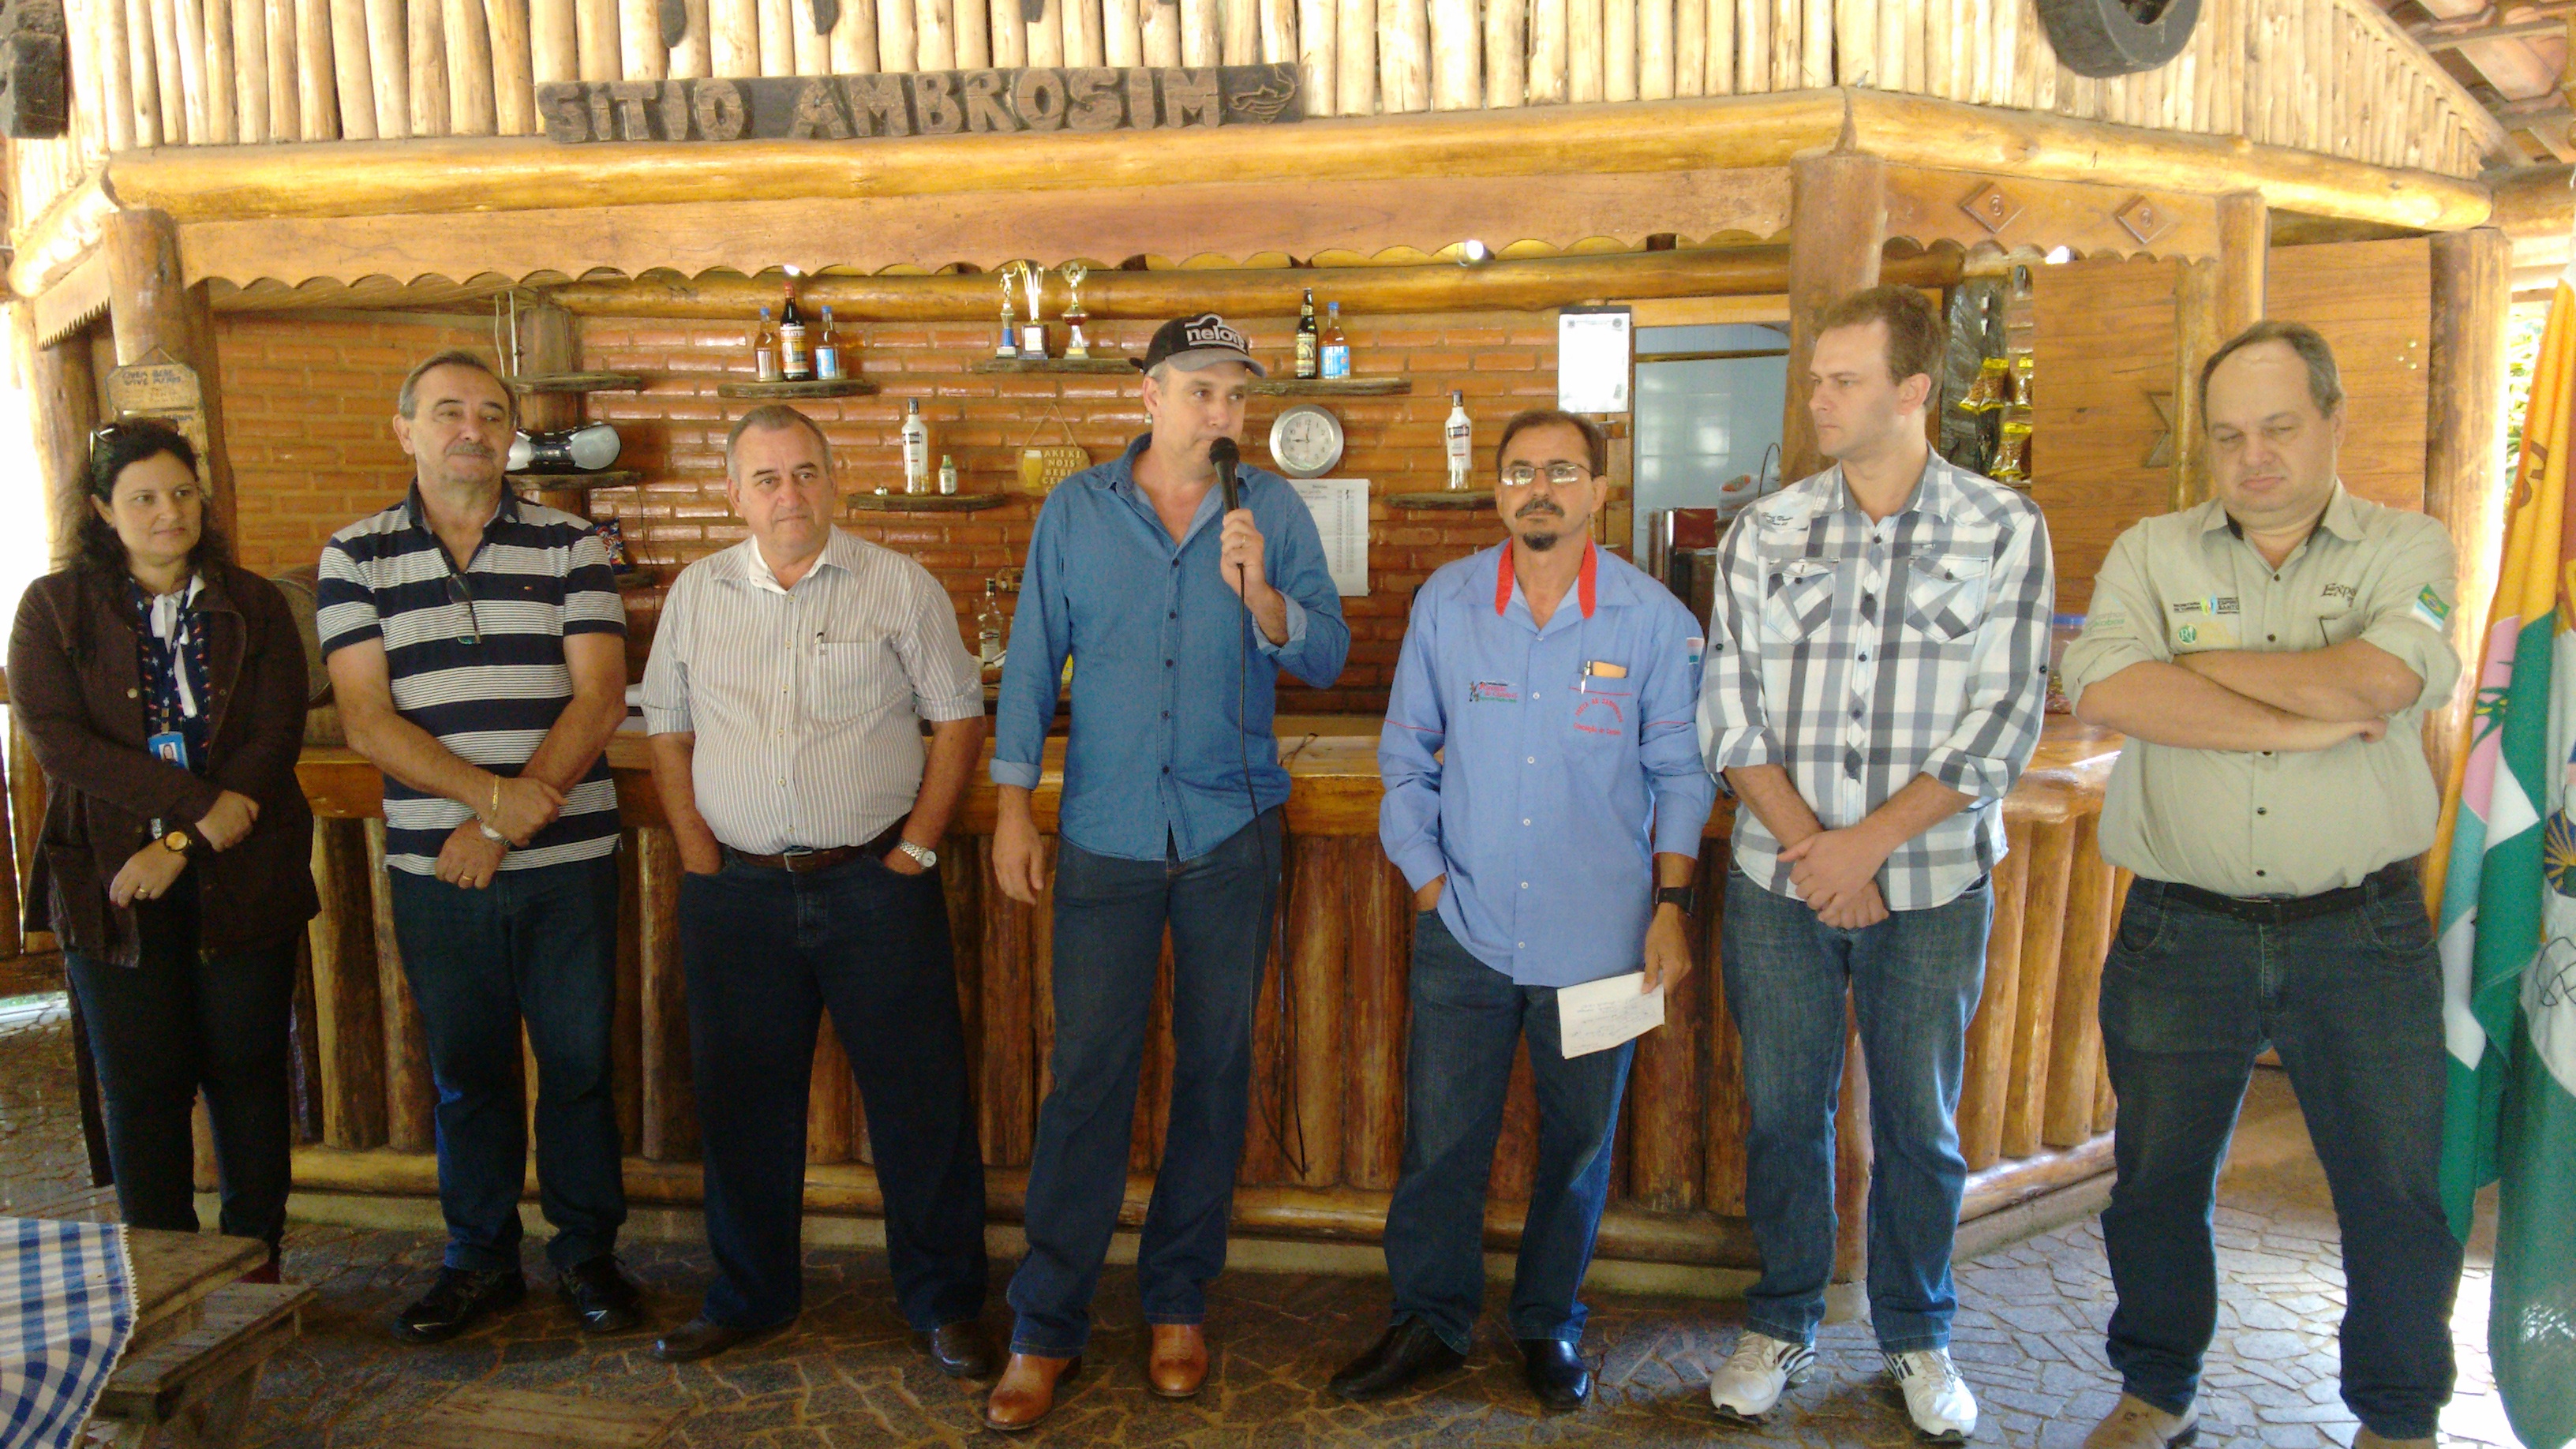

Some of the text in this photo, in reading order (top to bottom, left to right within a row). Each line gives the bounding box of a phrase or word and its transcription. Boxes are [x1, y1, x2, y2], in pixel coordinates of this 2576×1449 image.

[791, 66, 1219, 140] AMBROSIM
[1044, 449, 1081, 459] AKI KI
[1048, 459, 1076, 468] NOIS
